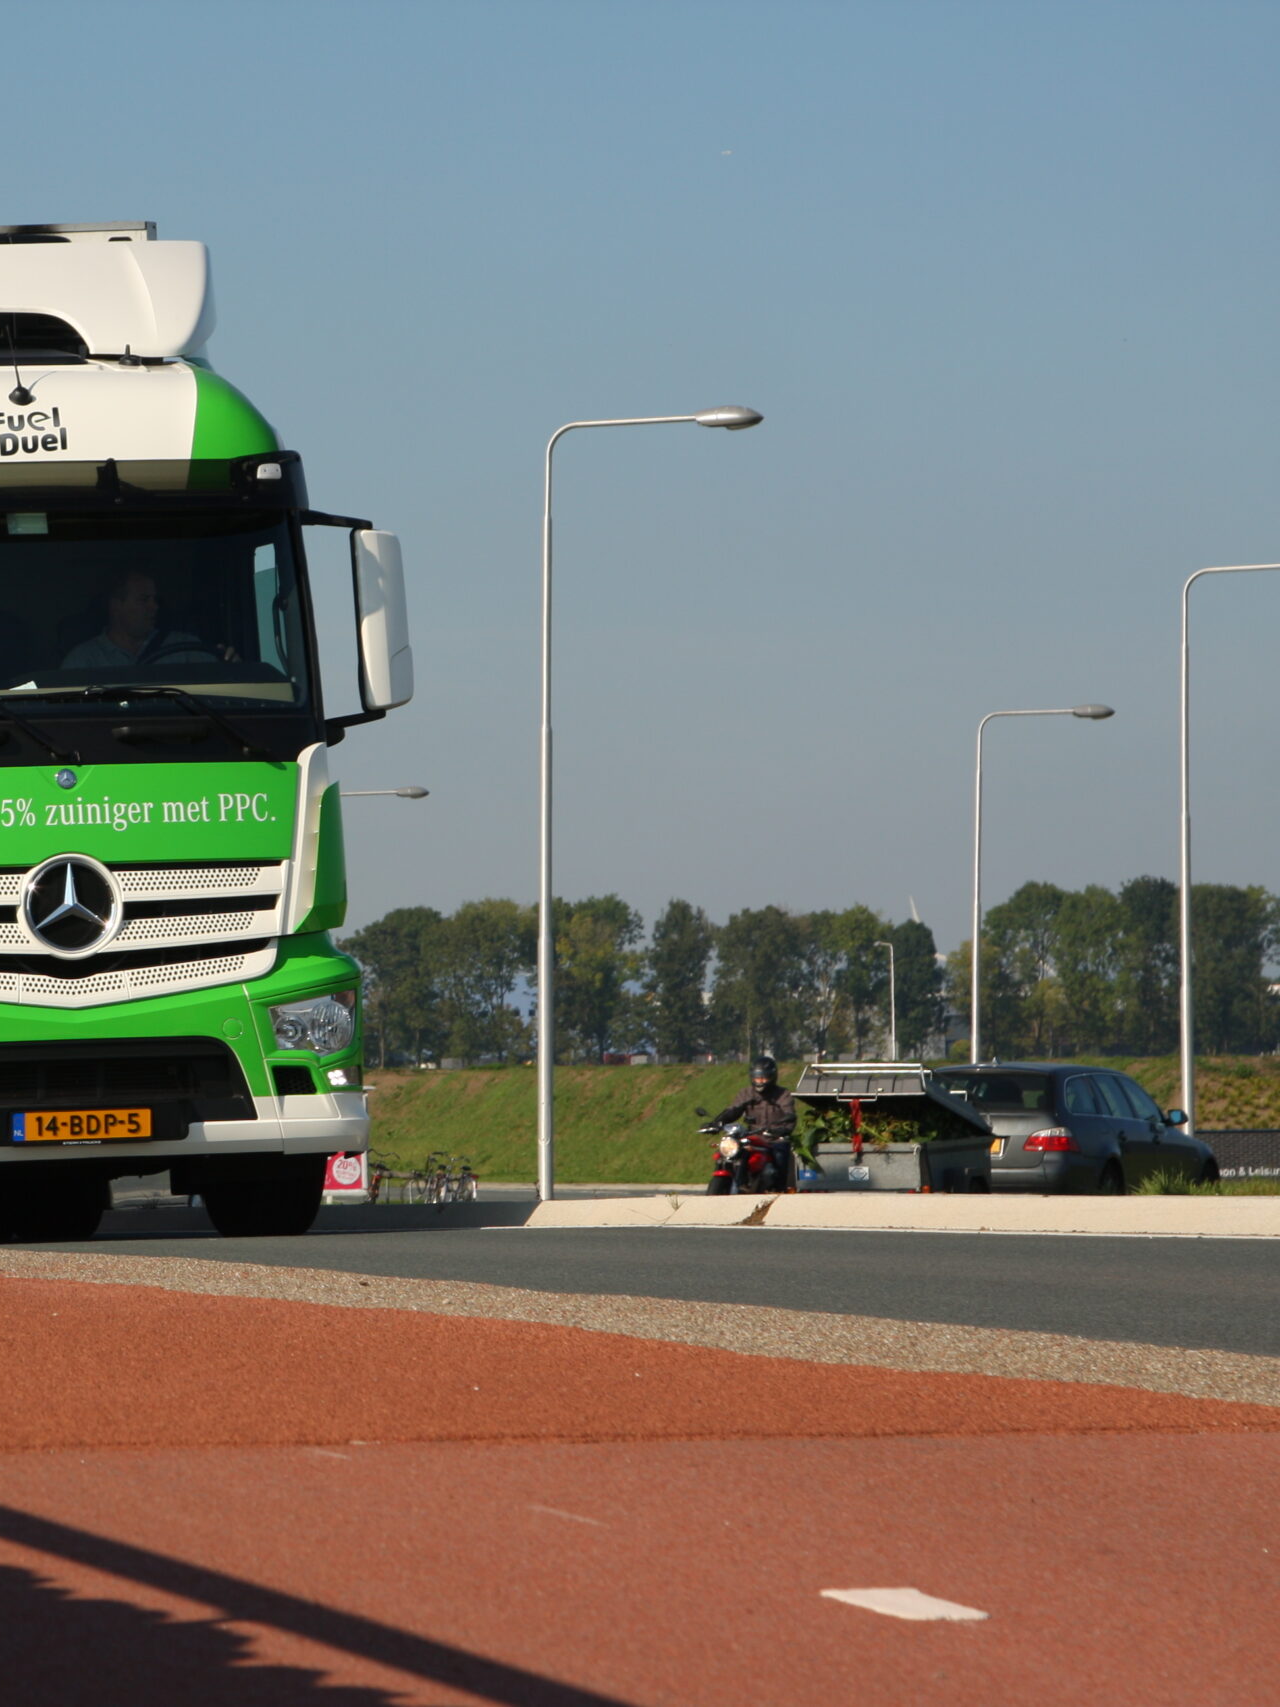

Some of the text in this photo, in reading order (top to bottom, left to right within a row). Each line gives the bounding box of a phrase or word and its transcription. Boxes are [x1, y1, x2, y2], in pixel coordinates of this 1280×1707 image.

[0, 427, 67, 456] Duel
[0, 798, 35, 827] 5%
[45, 796, 153, 831] zuiniger
[162, 797, 210, 823] met
[218, 793, 276, 821] PPC.
[35, 1113, 141, 1136] 14-BDP-5
